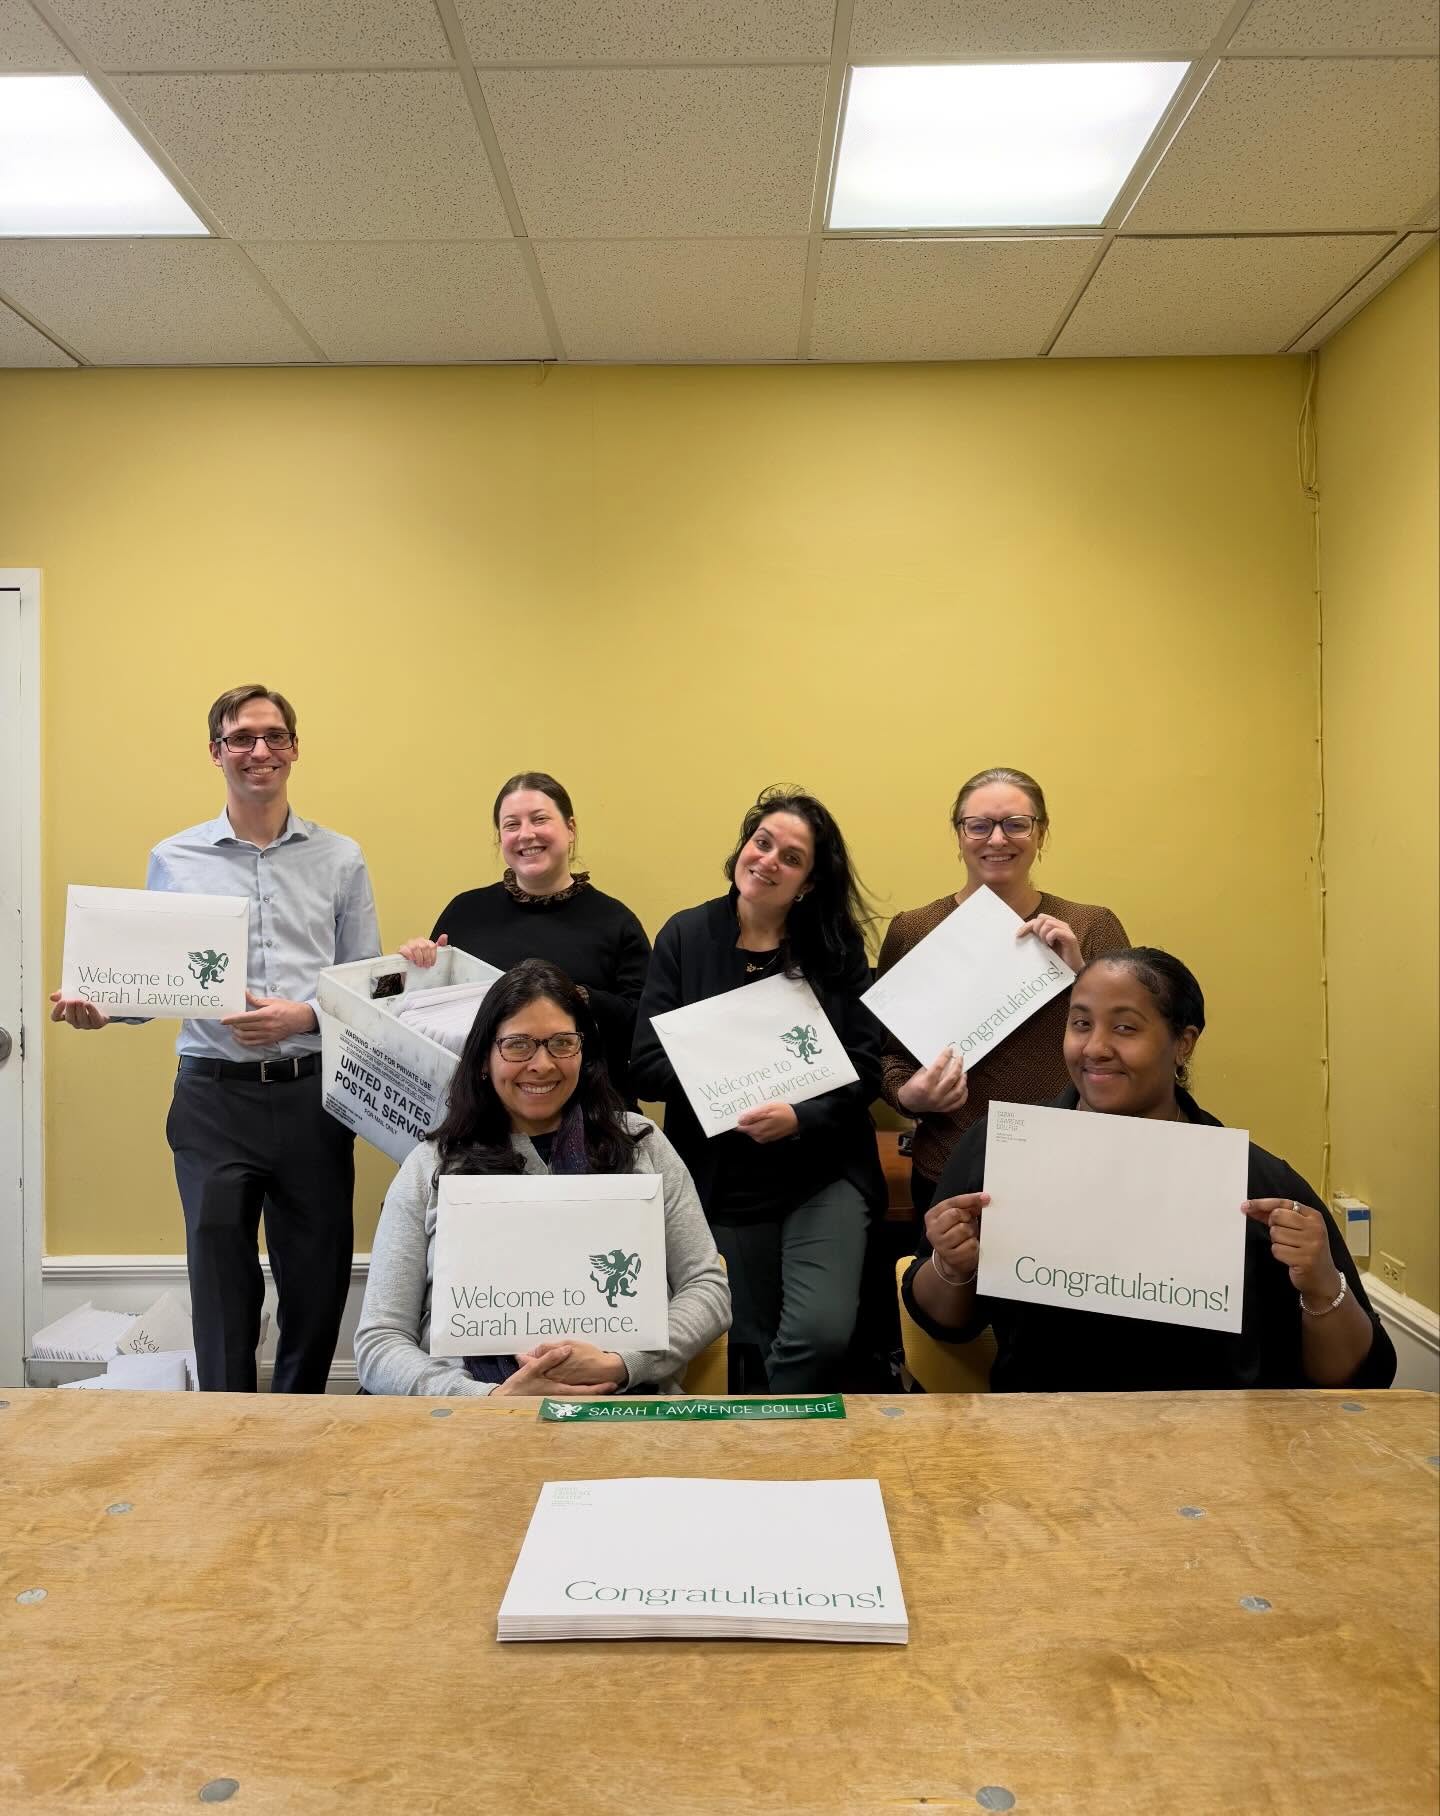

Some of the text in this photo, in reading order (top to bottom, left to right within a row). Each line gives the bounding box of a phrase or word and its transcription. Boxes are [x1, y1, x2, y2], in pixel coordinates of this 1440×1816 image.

[78, 966, 184, 987] Welcome to
[78, 985, 224, 1008] Sarah Lawrence.
[372, 1047, 384, 1059] NOT
[384, 1055, 396, 1067] FOR
[396, 1061, 420, 1085] PRIVATE
[419, 1078, 432, 1090] USE
[699, 1059, 792, 1102] Welcome to
[341, 1055, 382, 1092] UNITED
[384, 1084, 432, 1126] STATES
[709, 1066, 837, 1120] Sarah Lawrence.
[335, 1070, 379, 1111] POSTAL
[381, 1103, 429, 1143] SERVIC
[364, 1108, 374, 1120] FOR
[450, 1286, 585, 1309] Welcome to
[1015, 1255, 1229, 1312] Congratulations!
[450, 1312, 639, 1338] Sarah Lawrence.
[588, 1401, 839, 1417] SARAH LAWRENCE COLLEGE
[564, 1580, 886, 1610] Congratulations!
